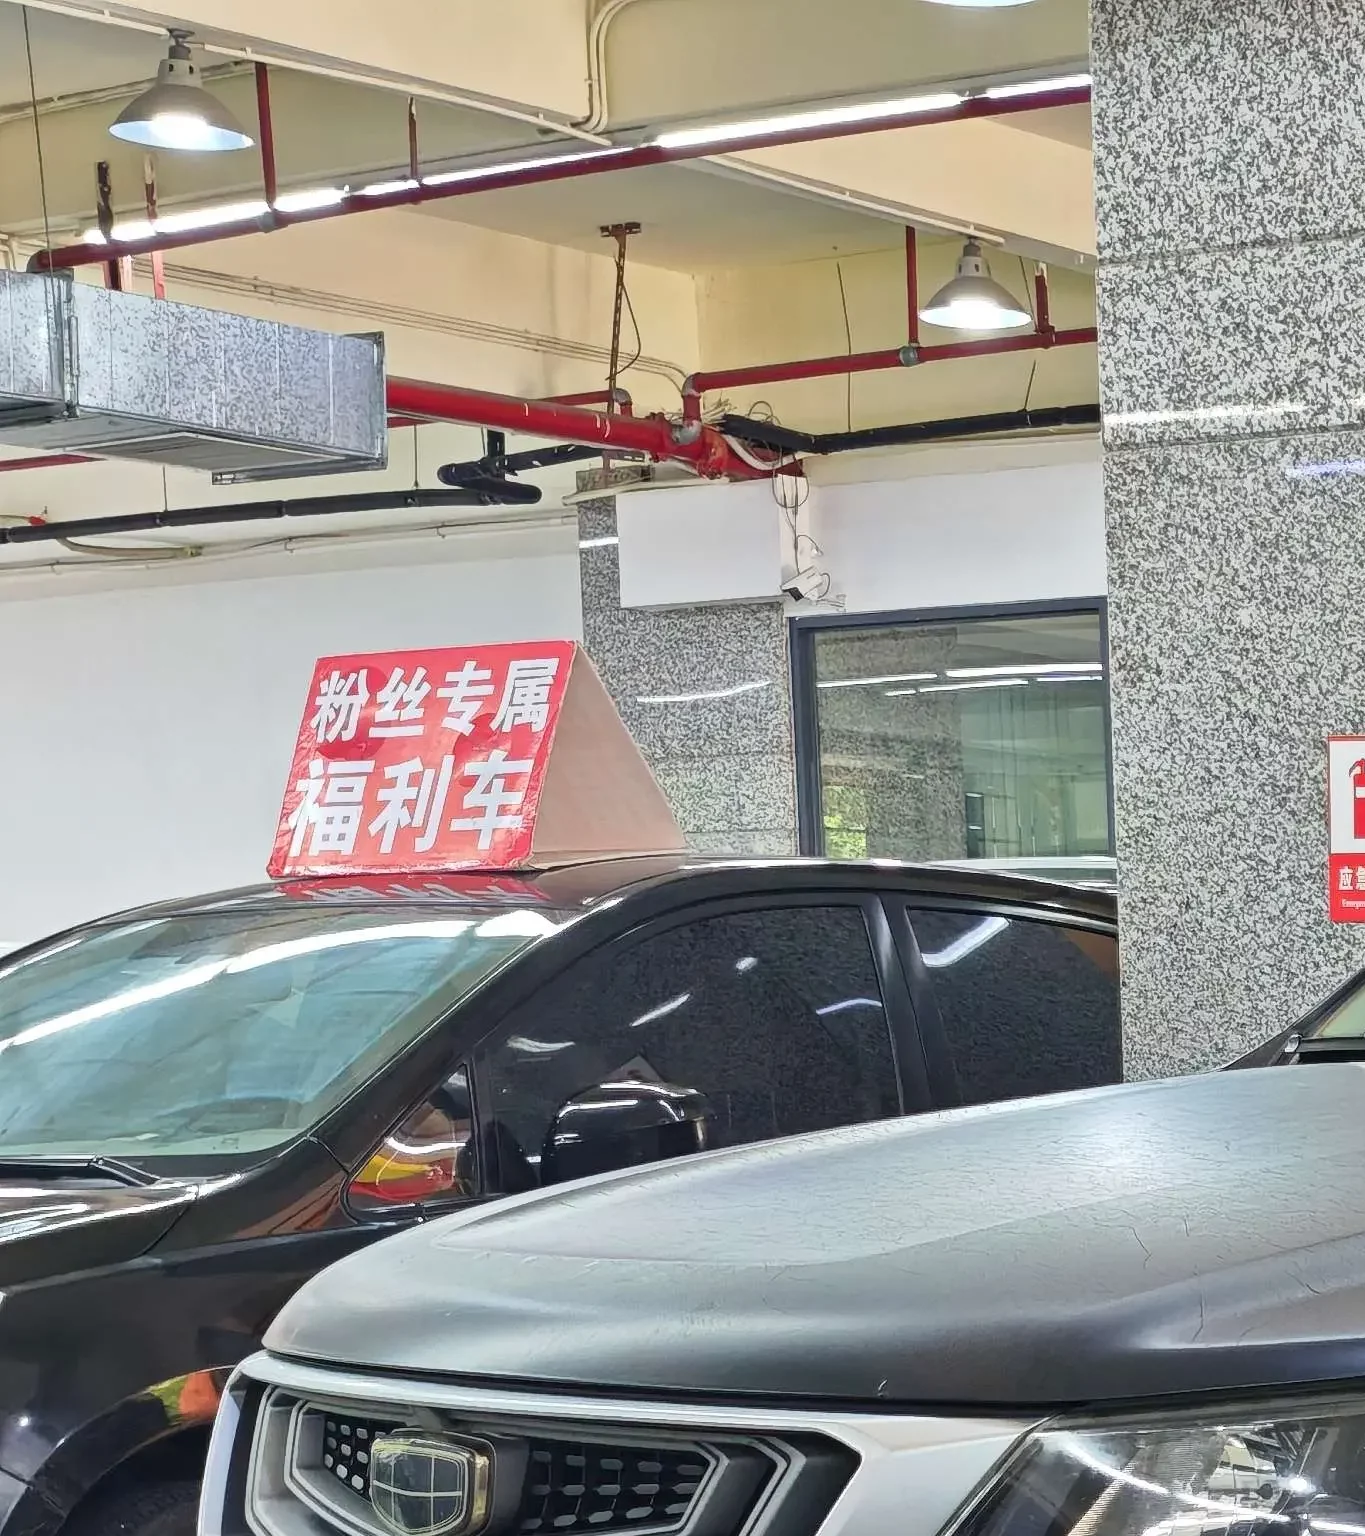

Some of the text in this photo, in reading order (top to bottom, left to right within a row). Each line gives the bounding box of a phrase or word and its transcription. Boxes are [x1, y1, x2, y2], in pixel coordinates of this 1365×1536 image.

[309, 657, 560, 744] 粉丝专属
[286, 749, 534, 857] 福利车
